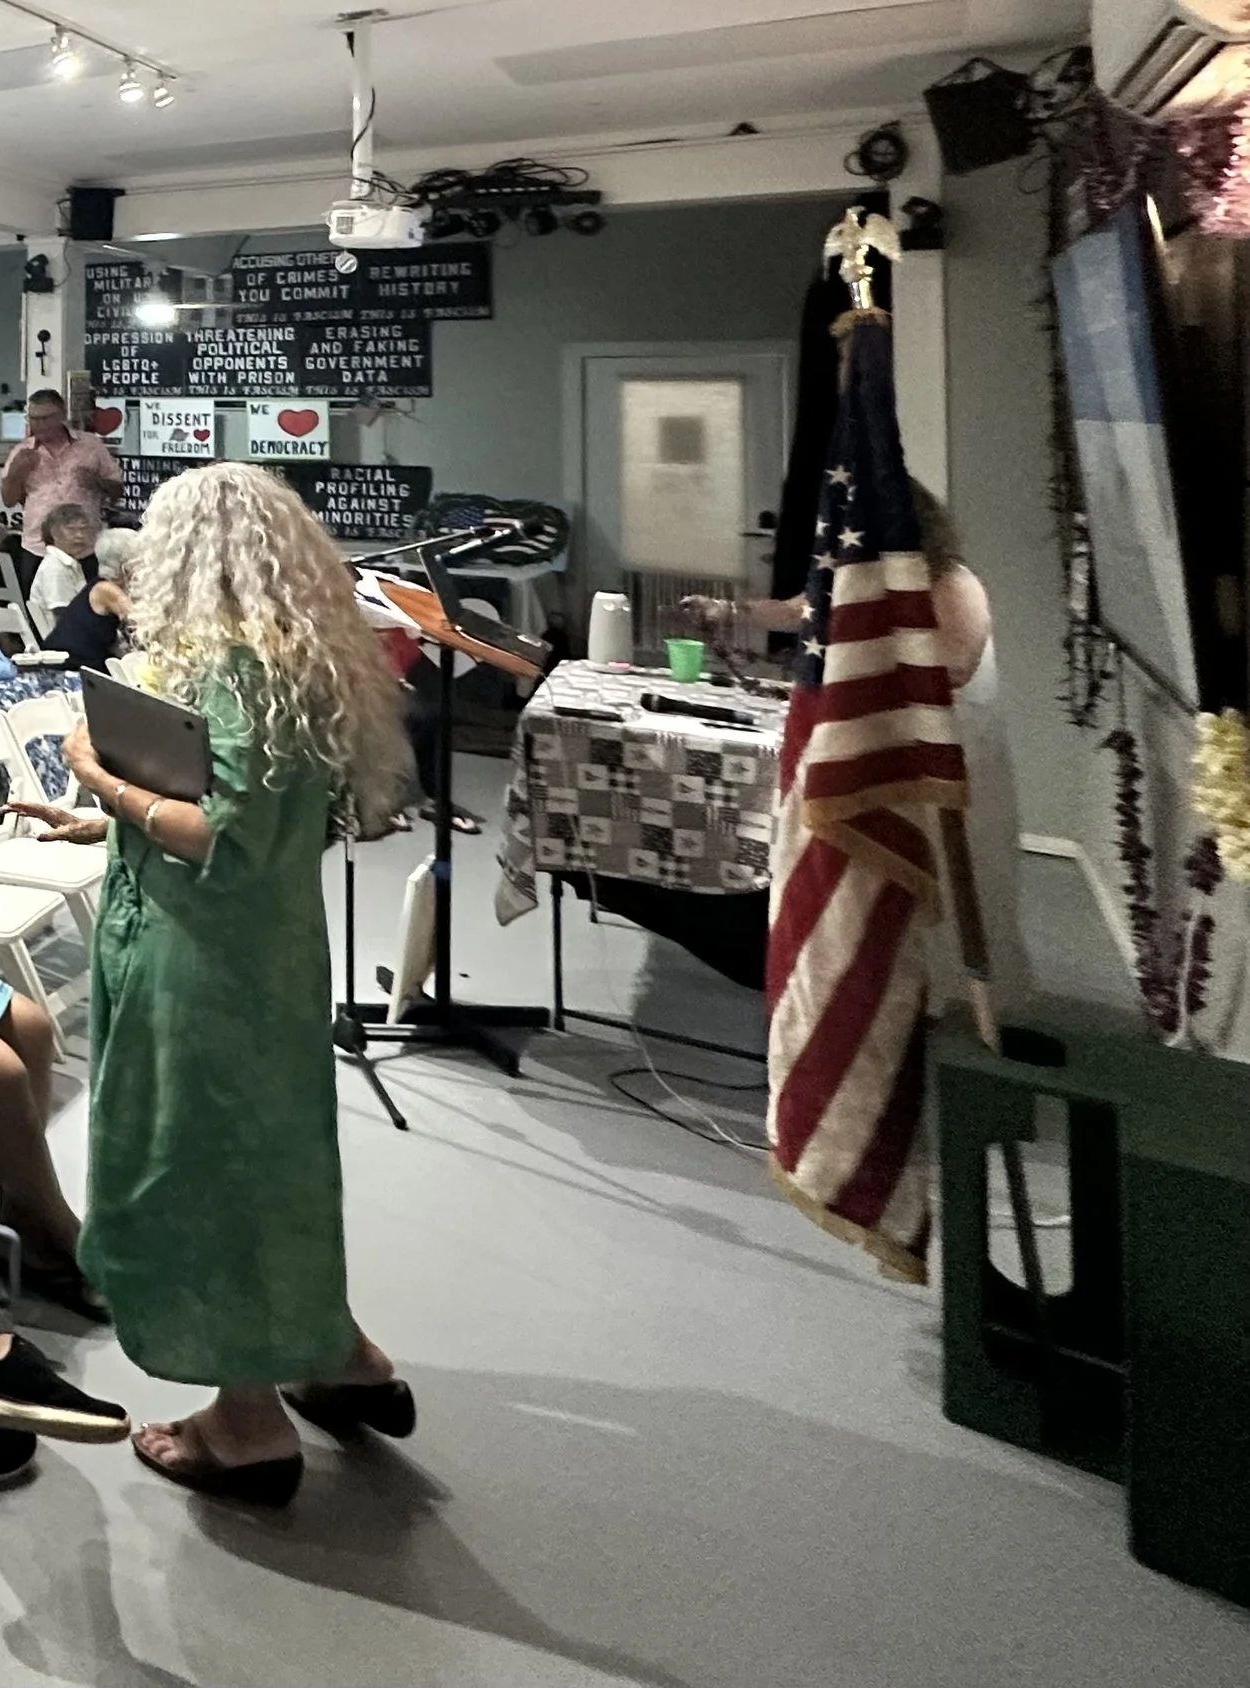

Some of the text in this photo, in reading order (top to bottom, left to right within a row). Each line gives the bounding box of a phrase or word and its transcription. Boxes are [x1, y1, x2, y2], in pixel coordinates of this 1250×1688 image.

[233, 254, 295, 269] ACCUSING
[246, 269, 339, 286] OF CRIMES
[369, 262, 471, 279] REWRITING
[239, 285, 350, 302] YOU COMMIT
[379, 281, 460, 296] HISTORY
[84, 332, 174, 344] OPPRESSION
[185, 327, 295, 342] THREATENING
[325, 325, 403, 339] ERASING
[121, 345, 139, 357] OF
[197, 341, 284, 356] POLITICAL
[310, 339, 420, 354] AND FAKING
[103, 359, 159, 371] LGBTQ+
[193, 356, 288, 370] OPPONENTS
[305, 355, 425, 369] GOVERNMENT
[102, 372, 159, 384] PEOPLE
[188, 371, 295, 384] WITH PRISON
[342, 370, 388, 382] DATA
[145, 402, 161, 410] WE
[250, 404, 269, 415] WE
[152, 413, 210, 425] DISSENT
[162, 442, 210, 453] FREEDOM
[251, 440, 328, 455] DEMOCRACY
[331, 467, 396, 481] RACIAL
[315, 481, 410, 497] PROFILING
[327, 497, 401, 512] AGAINST
[311, 510, 414, 527] MINORITIES
